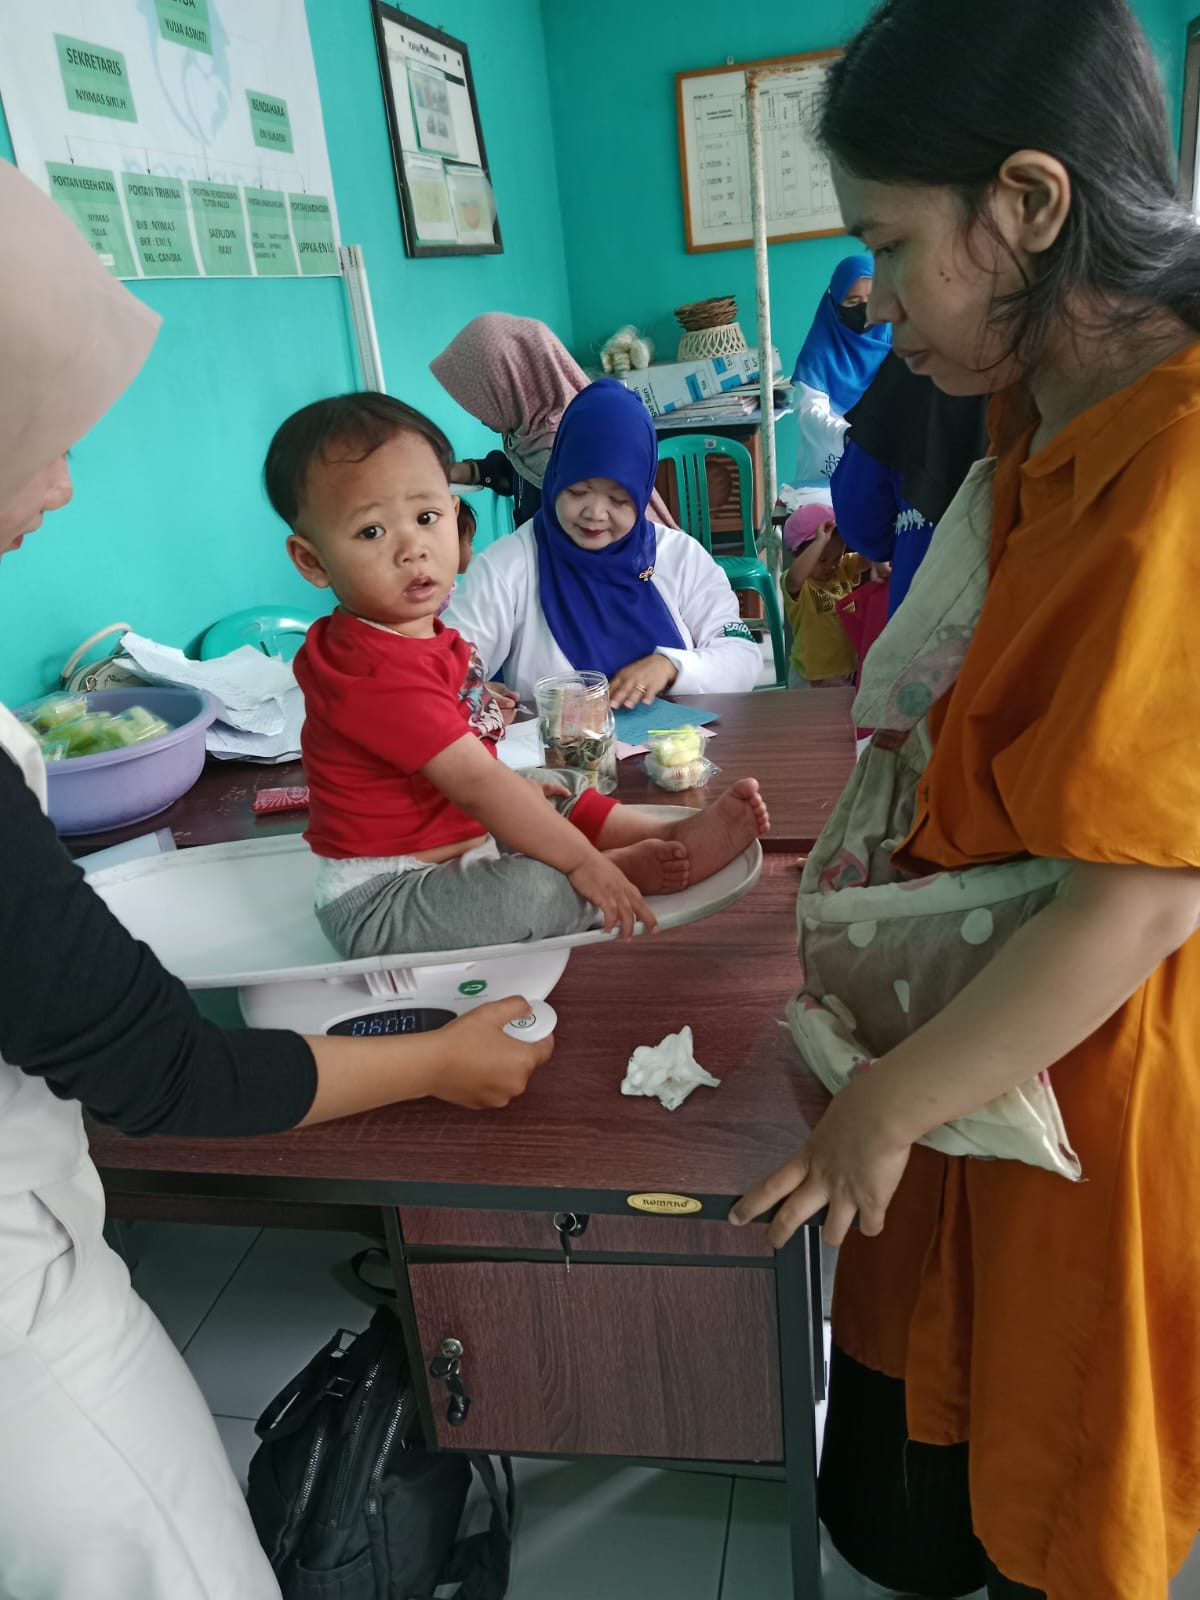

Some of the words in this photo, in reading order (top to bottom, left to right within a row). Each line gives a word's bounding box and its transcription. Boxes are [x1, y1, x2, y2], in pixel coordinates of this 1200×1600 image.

[66, 47, 122, 77] SEKRETARIS
[251, 98, 285, 118] BENDAHARA
[79, 178, 115, 192] KESEHATAN
